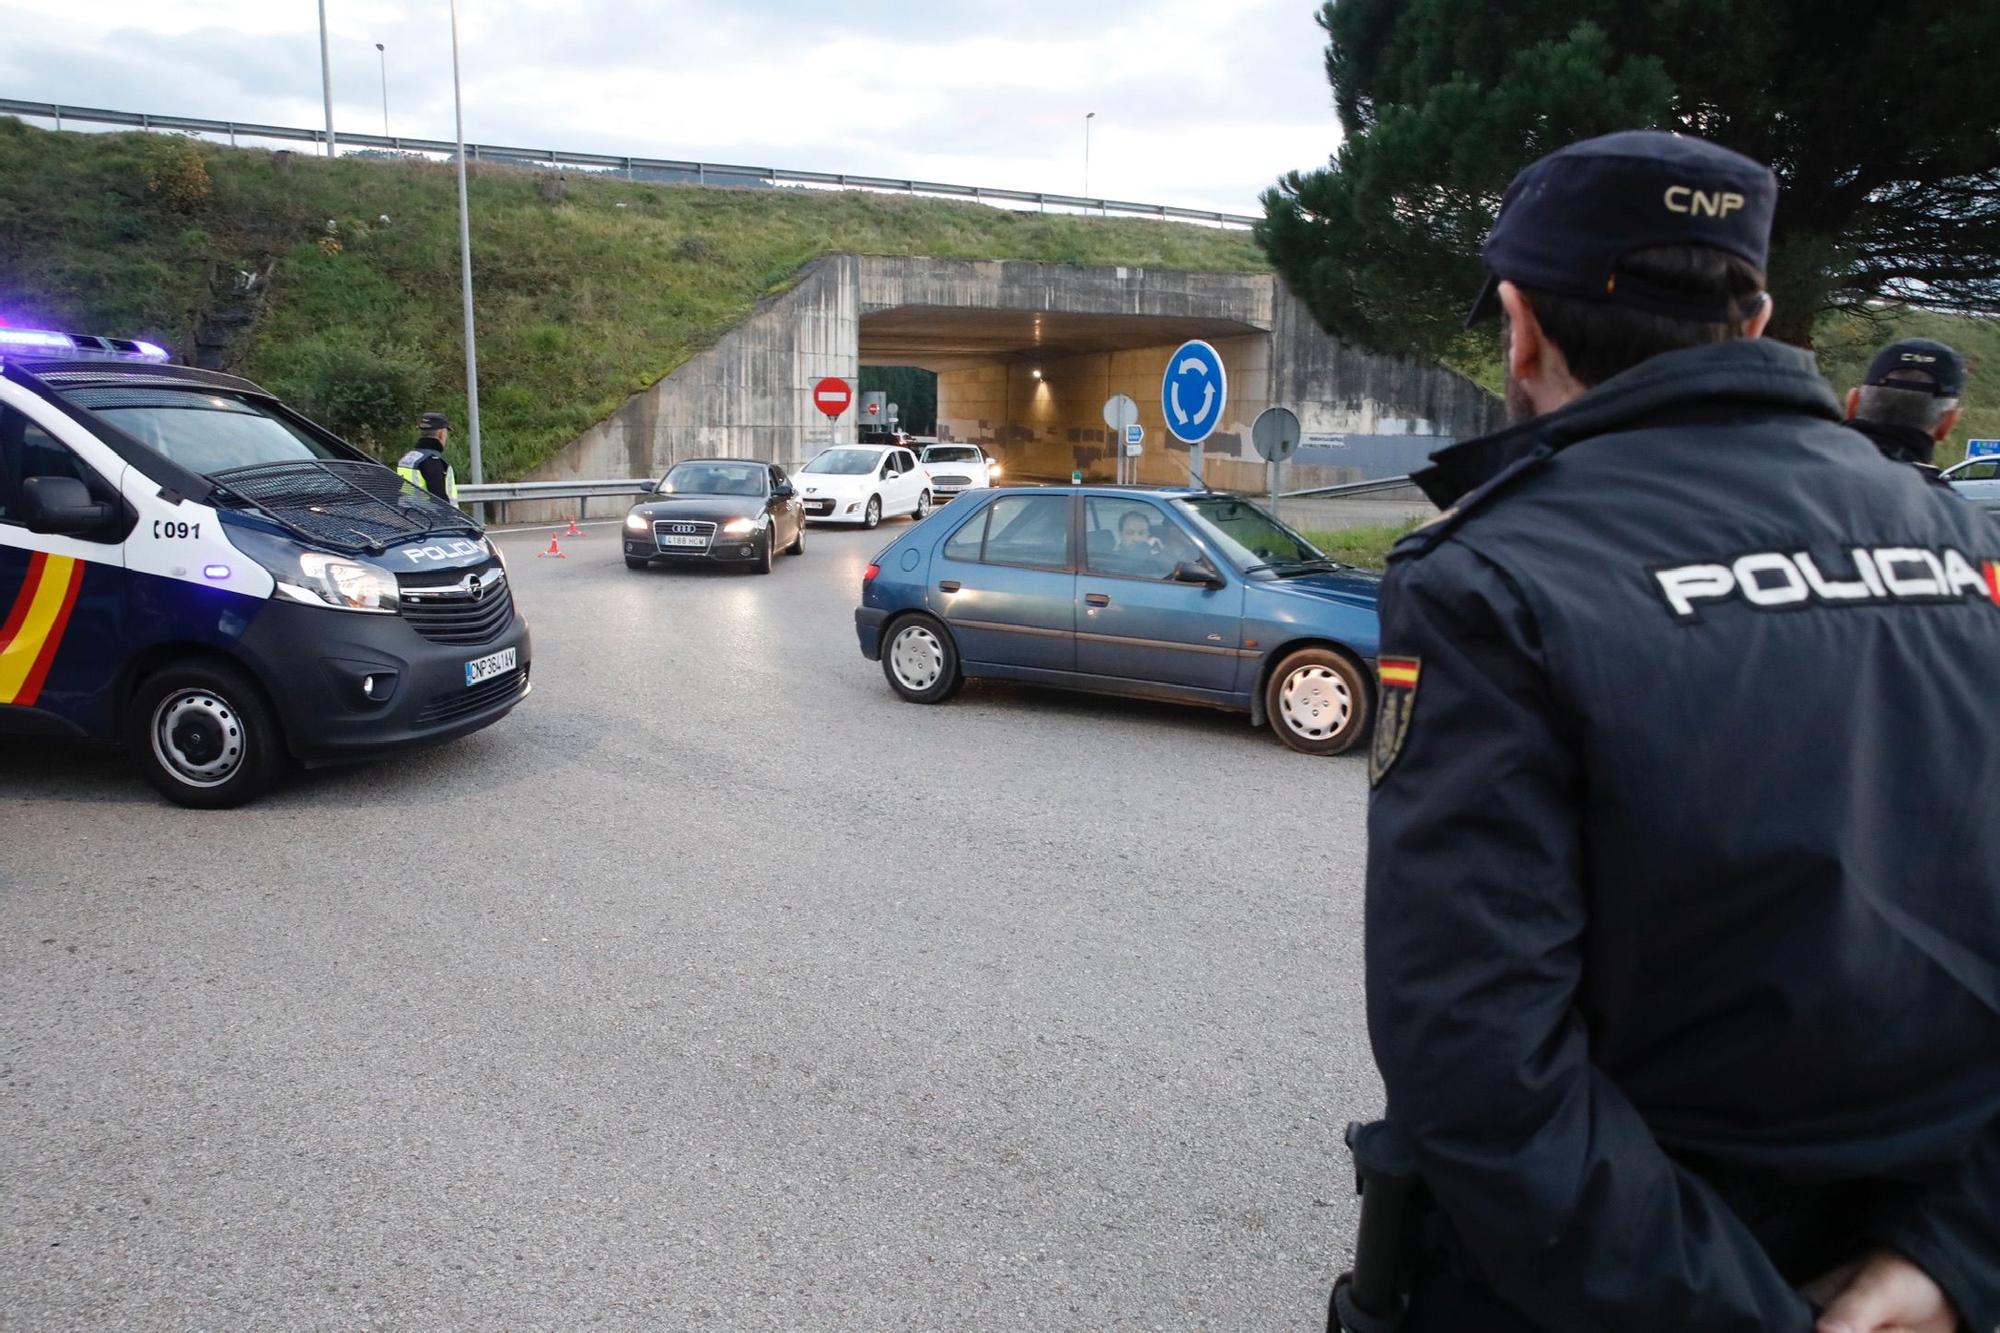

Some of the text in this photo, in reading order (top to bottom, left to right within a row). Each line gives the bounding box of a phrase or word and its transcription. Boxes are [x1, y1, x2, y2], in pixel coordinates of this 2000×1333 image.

[1664, 186, 1744, 218] CNP
[164, 521, 200, 539] 091
[1655, 547, 1991, 615] POLICIA
